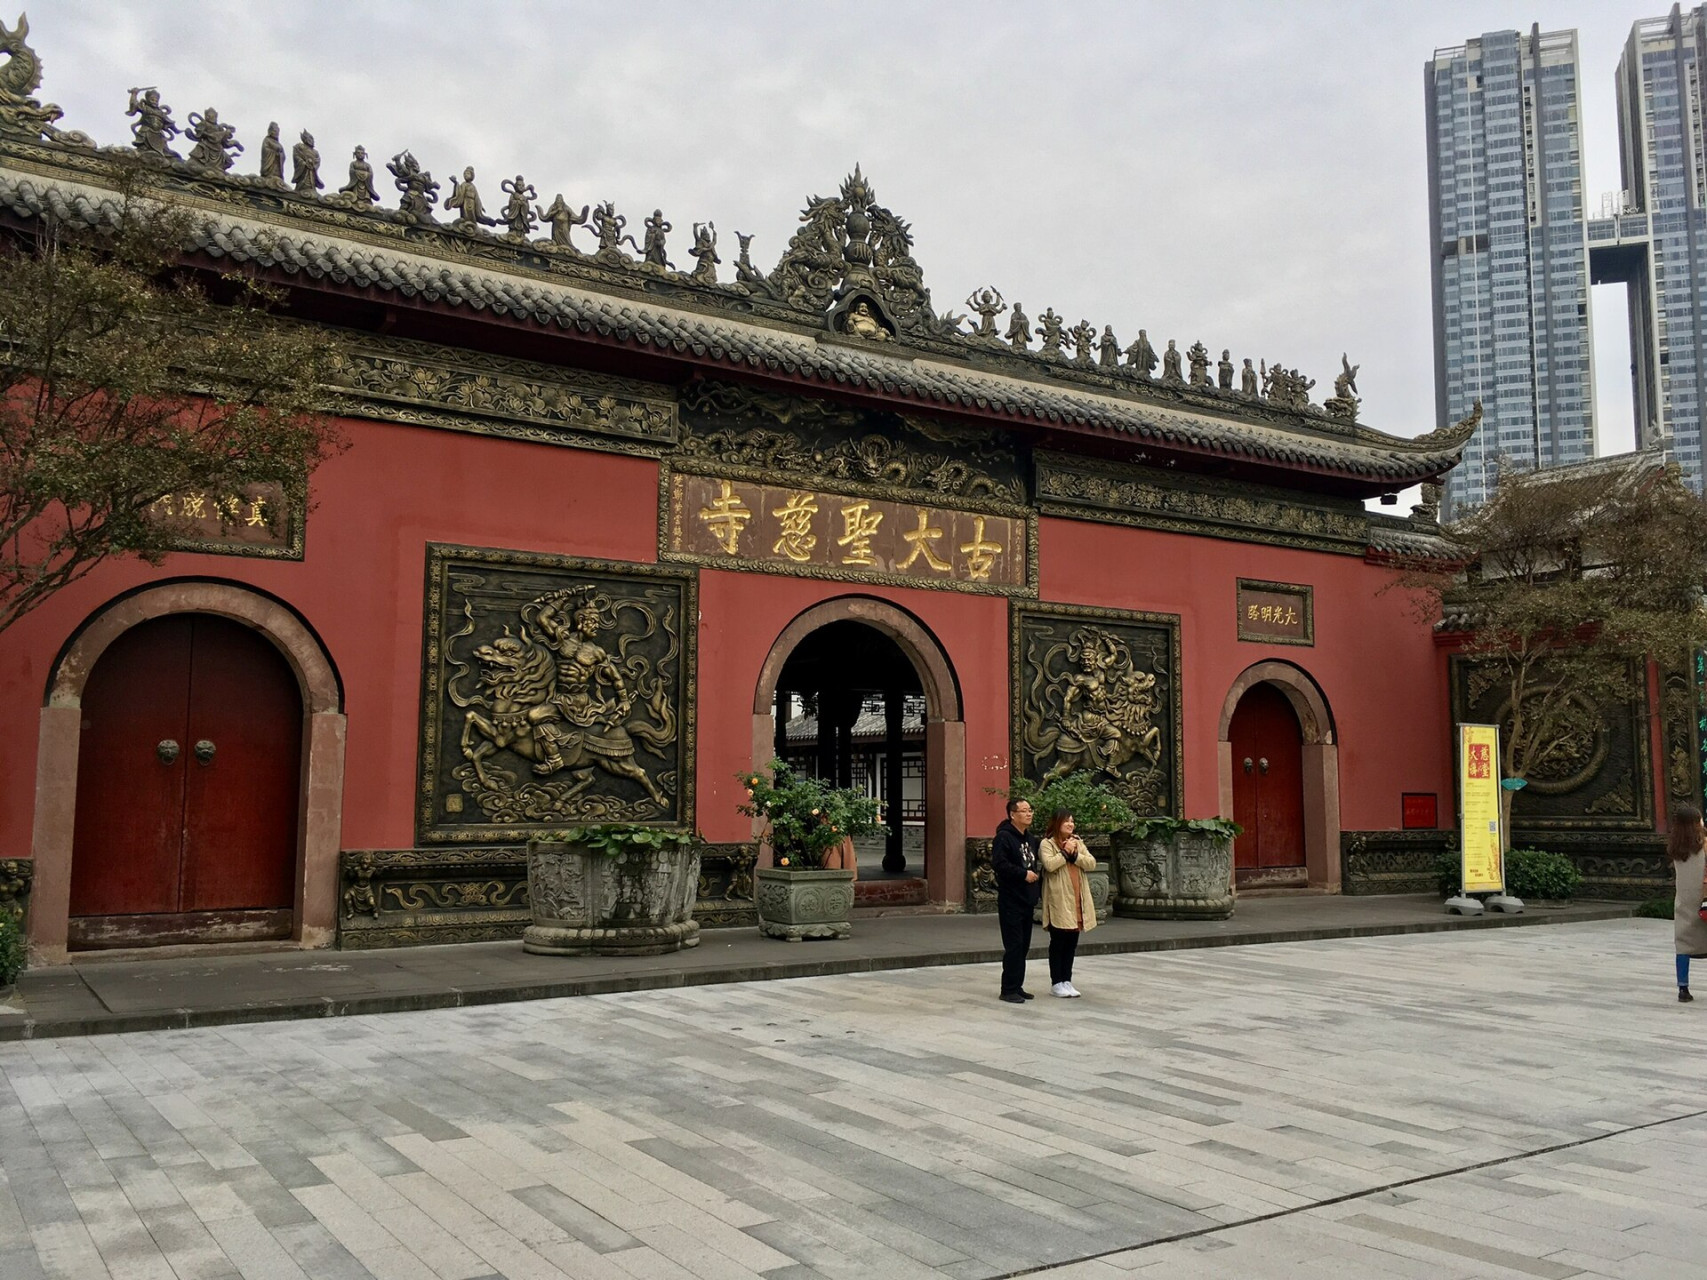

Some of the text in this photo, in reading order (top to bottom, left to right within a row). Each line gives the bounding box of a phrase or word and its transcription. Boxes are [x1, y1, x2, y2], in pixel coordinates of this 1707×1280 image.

[700, 479, 1003, 579] 古大聖慈寺
